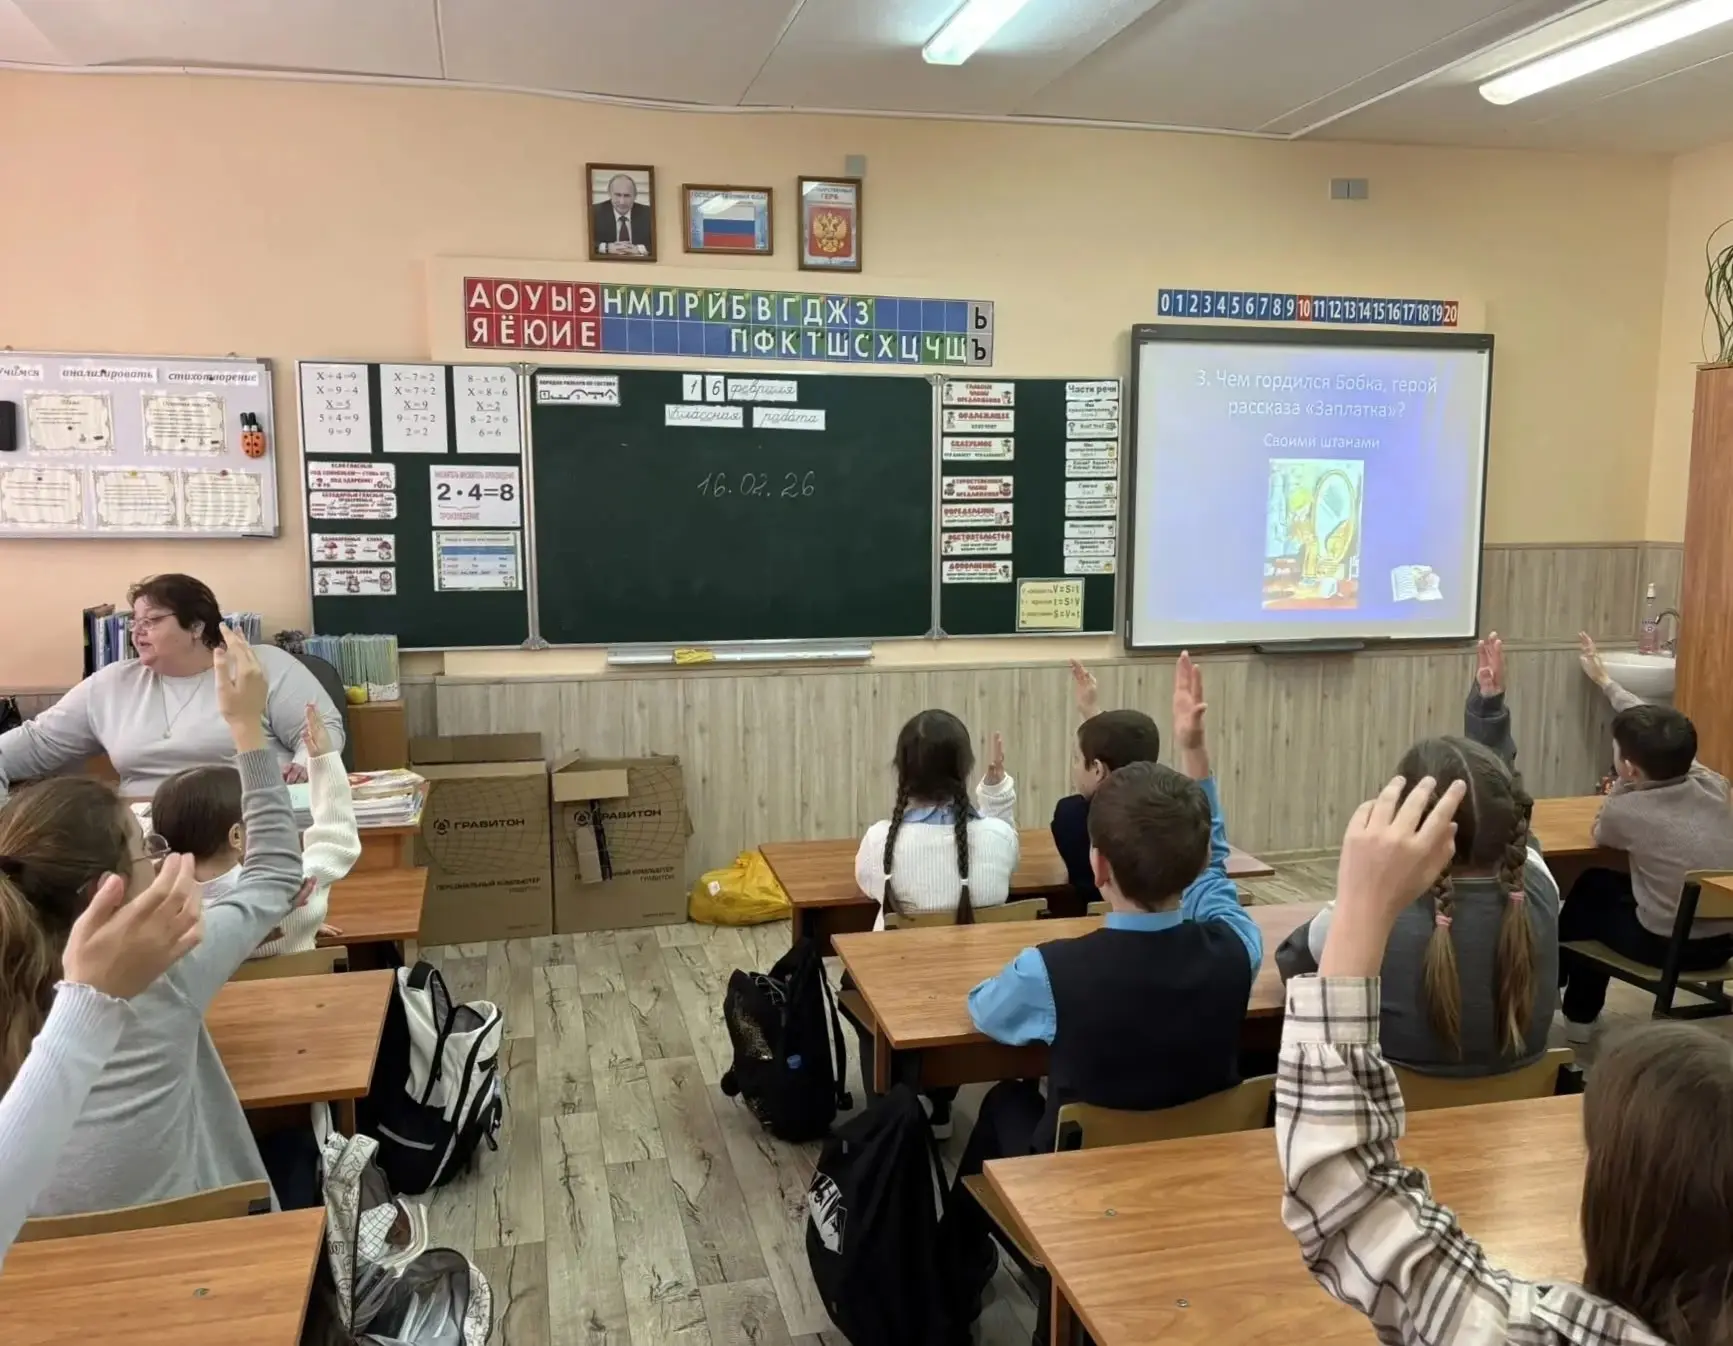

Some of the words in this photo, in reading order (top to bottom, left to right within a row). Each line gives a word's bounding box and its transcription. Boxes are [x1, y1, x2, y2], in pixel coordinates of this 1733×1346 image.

[469, 283, 491, 309] А
[496, 284, 518, 310] О
[524, 284, 543, 311] У
[552, 286, 572, 312] Ы
[579, 288, 596, 312] Э
[604, 289, 622, 315] Н
[628, 290, 650, 316] М
[656, 290, 674, 317] Л
[686, 290, 699, 318] Р
[708, 291, 726, 319] Й
[732, 296, 746, 320] Б
[758, 296, 772, 320] В
[783, 297, 796, 322] Г
[804, 299, 822, 326] Д
[828, 299, 848, 324] Ж
[855, 300, 870, 326] З
[975, 306, 987, 329] Ь
[1160, 294, 1170, 312] 0
[1176, 294, 1183, 312] 1
[1190, 294, 1198, 312] 2
[1204, 295, 1212, 313] 3
[1216, 296, 1226, 314] 4
[1232, 296, 1240, 314] 5
[1246, 297, 1254, 315] 6
[1260, 298, 1268, 316] 7
[1272, 298, 1282, 316] 8
[1286, 298, 1294, 316] 9
[1298, 299, 1310, 317] 10
[1314, 300, 1324, 318] 11
[1328, 300, 1341, 318] 12
[1344, 301, 1356, 320] 13
[1358, 302, 1371, 320] 14
[1373, 302, 1384, 320] 15
[1388, 302, 1400, 320] 16
[1403, 303, 1415, 321] 17
[1418, 304, 1429, 322] 18
[1432, 304, 1442, 322] 19
[1444, 305, 1456, 322] 20
[472, 317, 488, 342] Я
[501, 315, 515, 344] Ё
[524, 319, 547, 346] Ю
[552, 320, 572, 346] И
[582, 322, 596, 347] Е
[731, 329, 748, 352] П
[754, 330, 774, 354] Ф
[782, 331, 796, 355] К
[806, 332, 821, 356] Т
[828, 332, 848, 356] Ш
[854, 334, 870, 358] С
[878, 334, 894, 358] Х
[902, 336, 918, 362] Ц
[926, 336, 940, 360] Ч
[946, 337, 967, 362] Щ
[971, 338, 986, 361] Ъ
[690, 380, 698, 394] 1
[712, 380, 722, 396] 6
[730, 378, 795, 400] февраля
[1068, 384, 1094, 393] Части
[1096, 386, 1116, 395] речи
[1196, 370, 1210, 386] 3.
[1216, 370, 1250, 388] Чем
[1255, 374, 1330, 395] гордился
[1336, 374, 1386, 393] Бобка,
[1392, 377, 1438, 396] герой
[668, 406, 741, 422] Классная
[760, 410, 819, 428] работа
[1228, 401, 1300, 418] рассказа
[1306, 400, 1406, 418] «Заплатка»?
[1263, 432, 1317, 448] Своими
[1320, 435, 1380, 449] штанами
[454, 819, 525, 830] ГРАВИТОН
[601, 809, 662, 820] РАВИТОН
